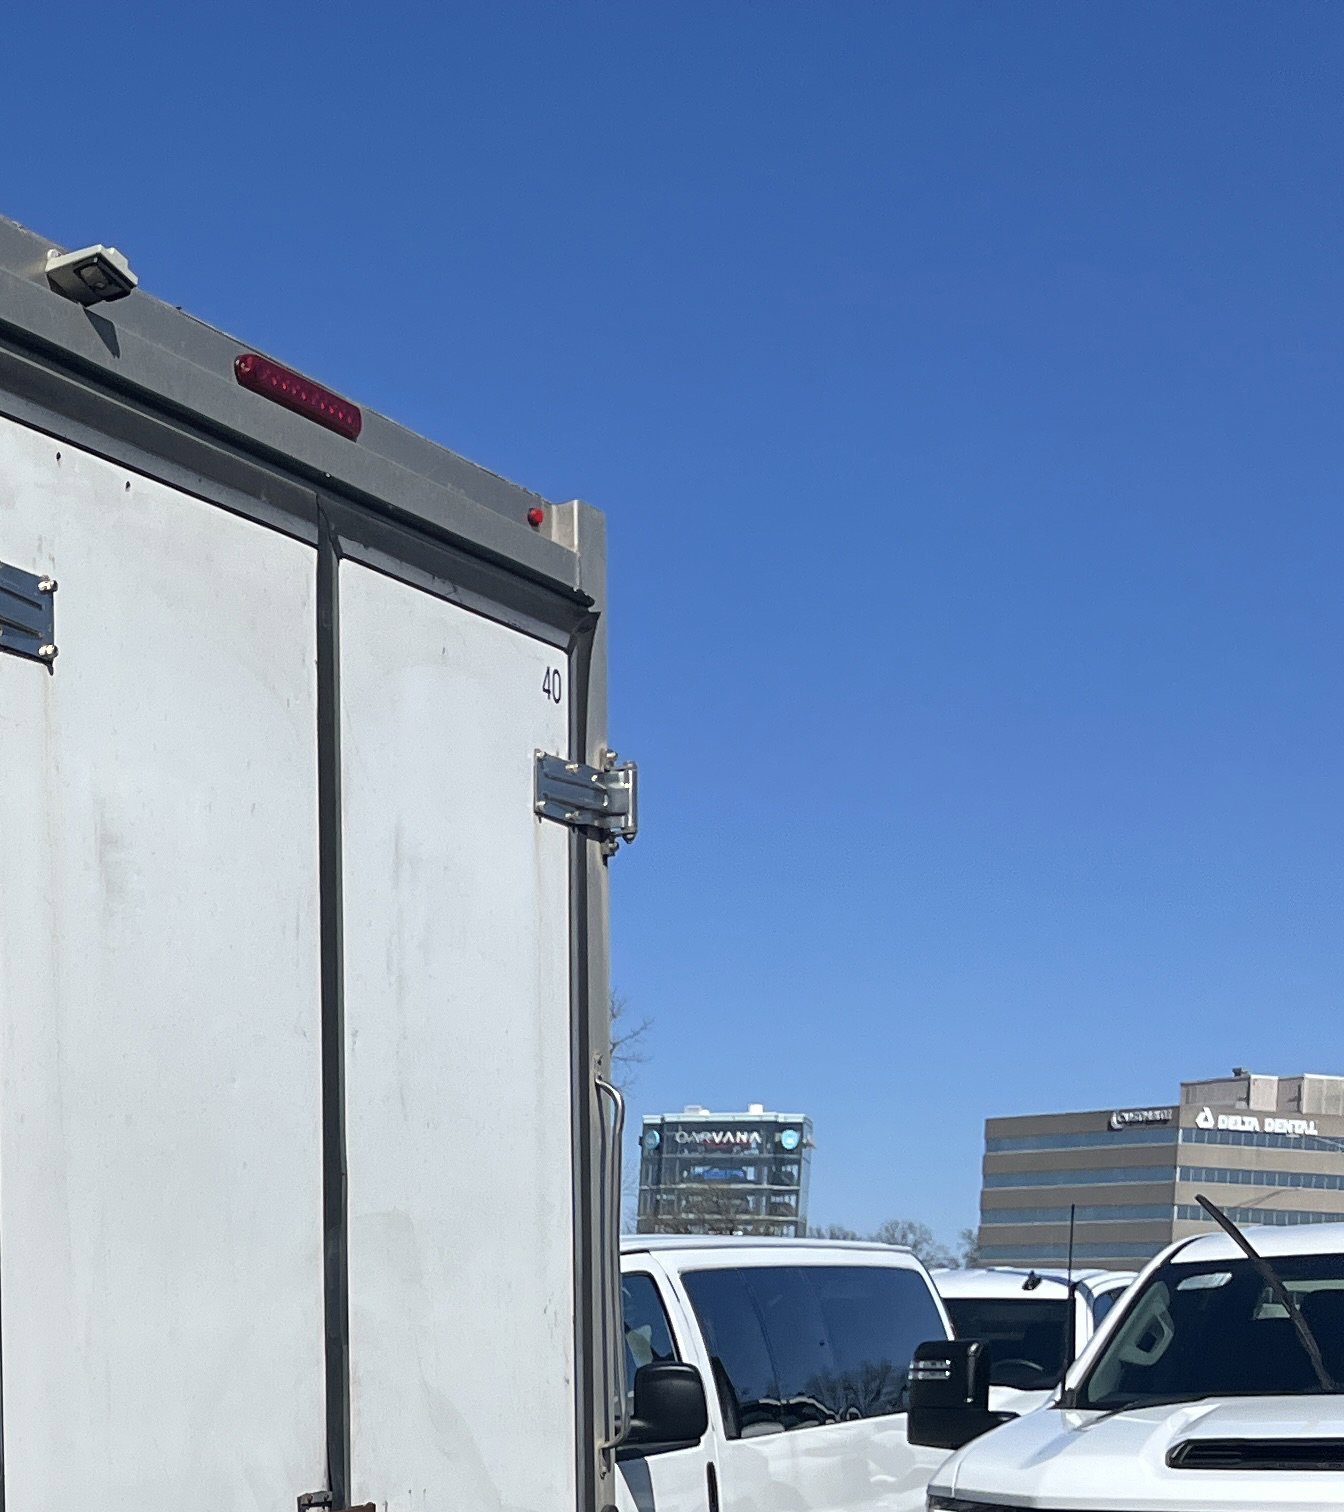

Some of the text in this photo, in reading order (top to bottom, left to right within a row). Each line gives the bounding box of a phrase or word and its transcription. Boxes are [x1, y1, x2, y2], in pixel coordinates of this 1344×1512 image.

[542, 667, 561, 704] 40
[1217, 1114, 1318, 1136] DELTA DENTAL
[675, 1130, 762, 1144] CARVANA
